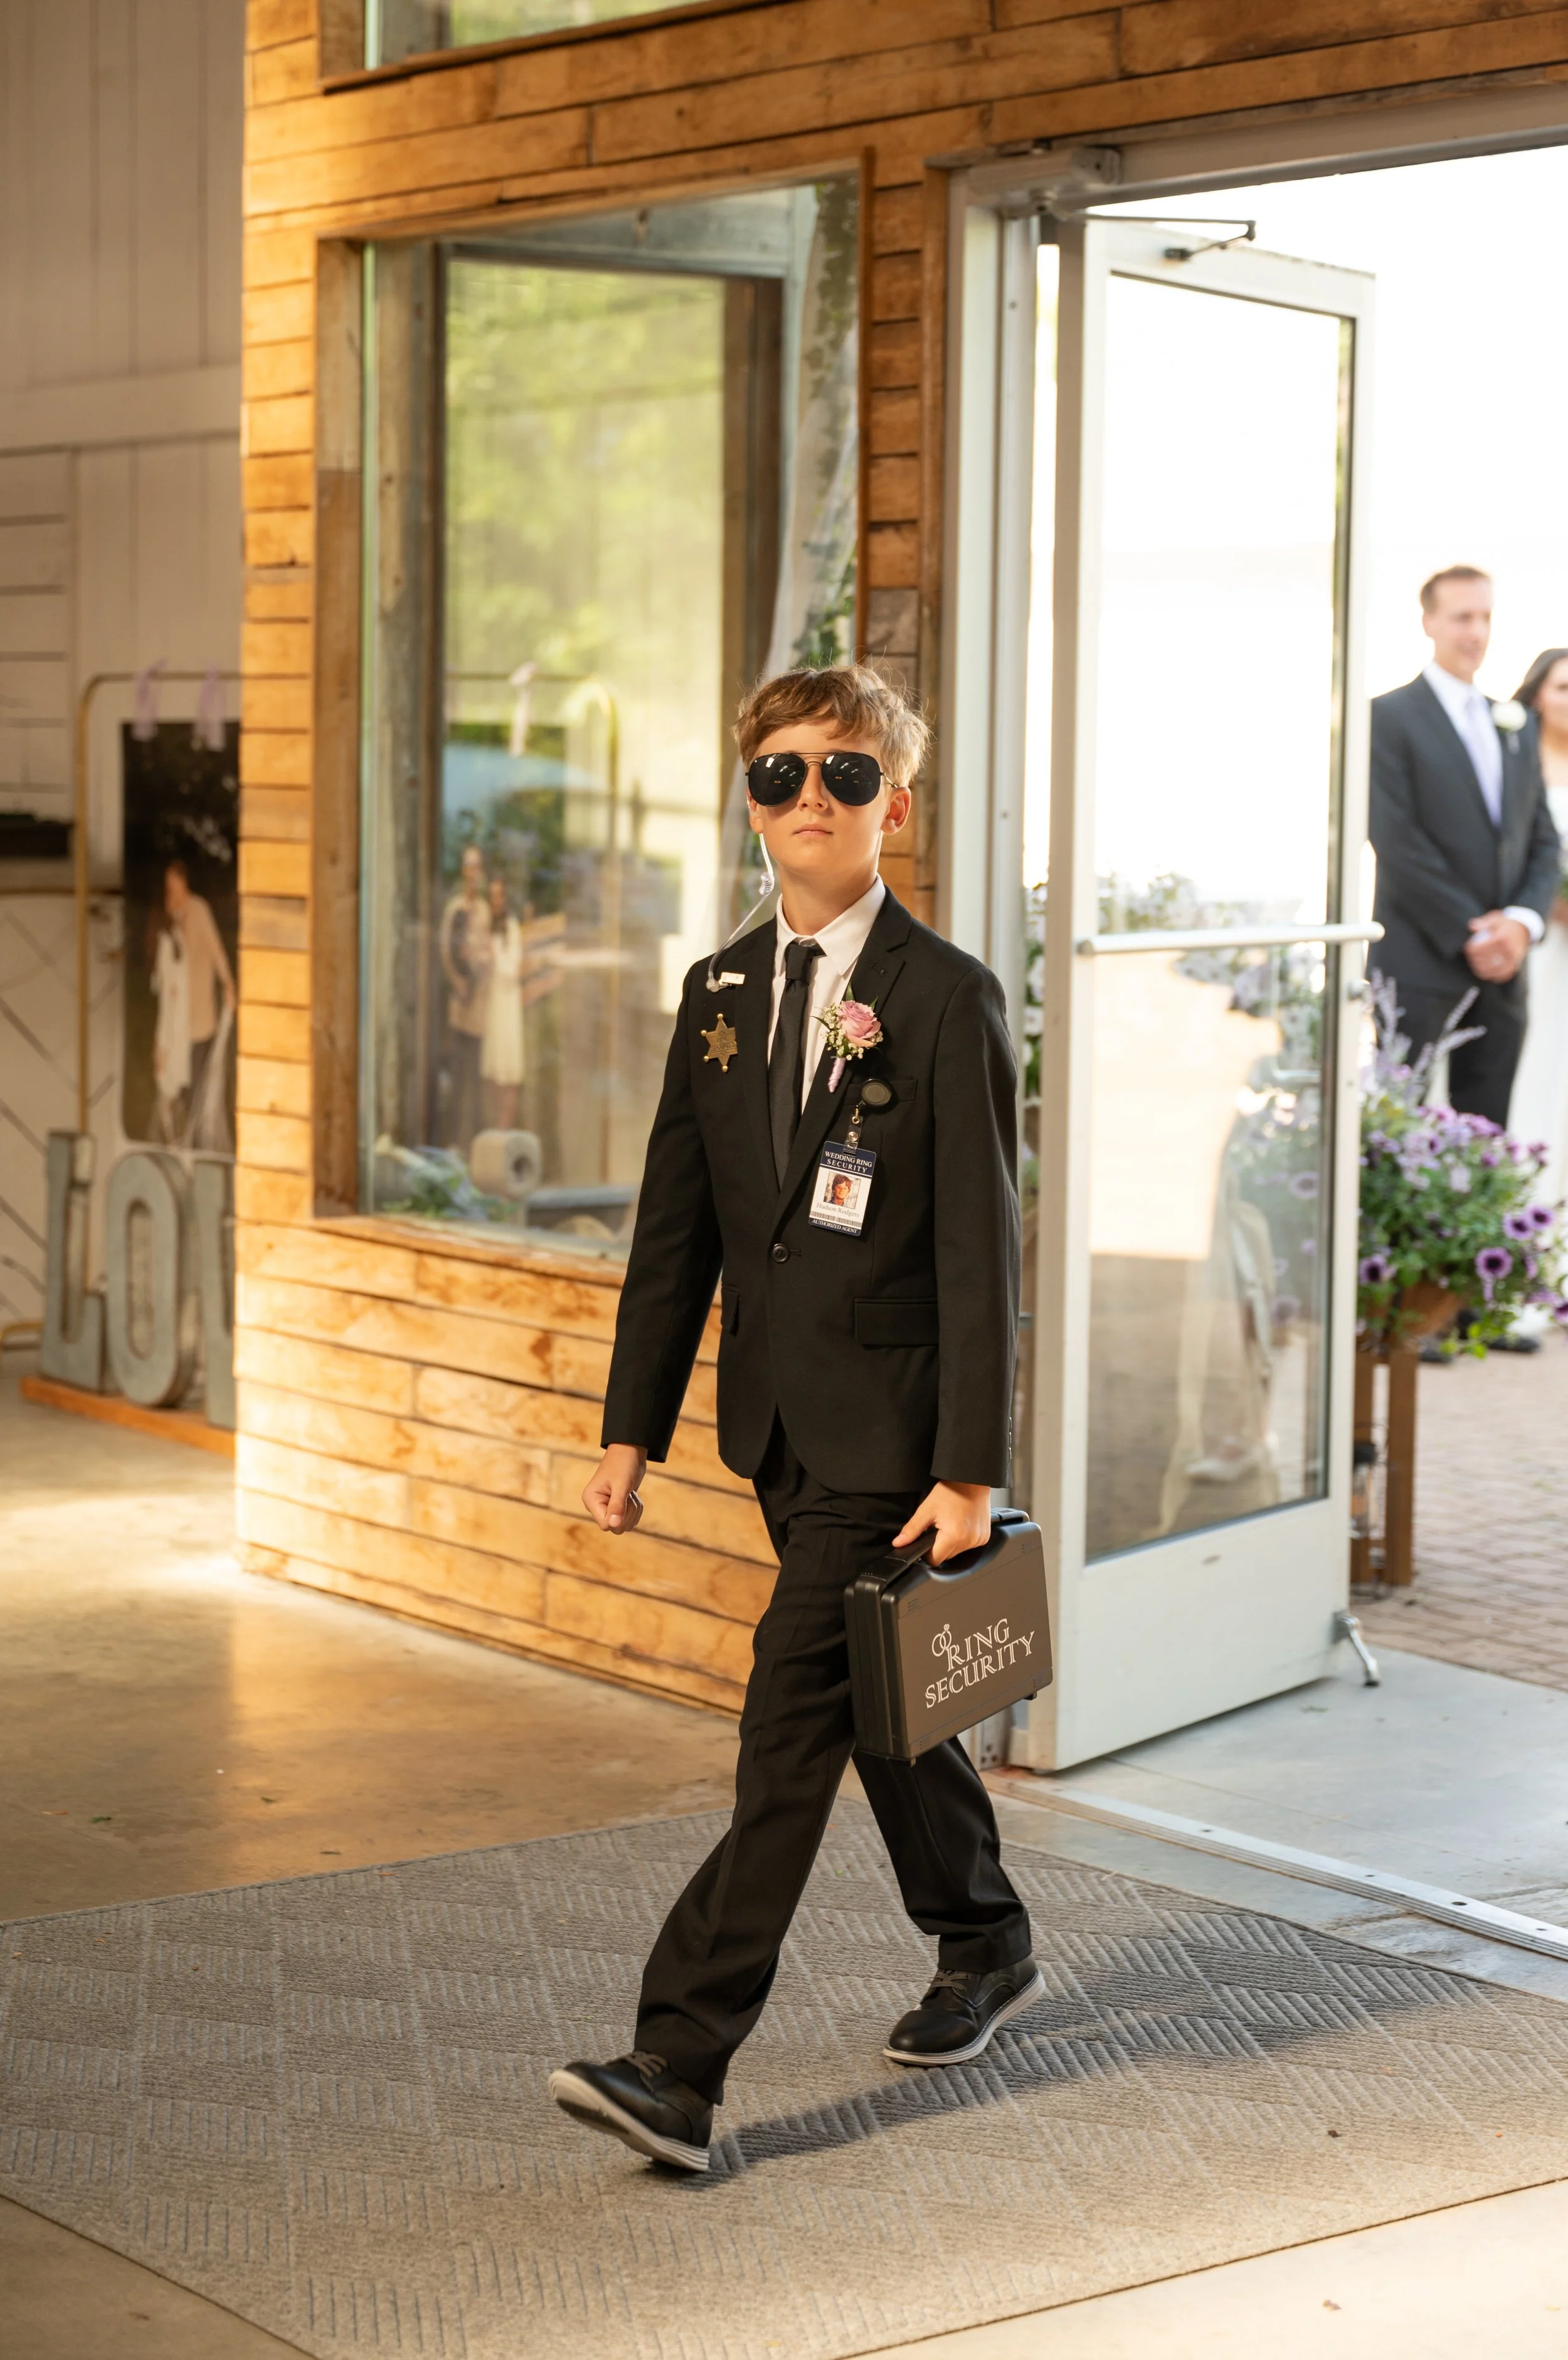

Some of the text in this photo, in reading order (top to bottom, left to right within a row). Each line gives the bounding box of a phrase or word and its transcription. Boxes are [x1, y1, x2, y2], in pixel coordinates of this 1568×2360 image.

[825, 1151, 872, 1167] WEDDING RING
[827, 1159, 867, 1173] SECURITY
[817, 1203, 859, 1218] Hudson Rodgers
[812, 1219, 841, 1230] AUTHORIZED
[947, 1618, 1010, 1672] RING
[925, 1631, 1035, 1708] SECURITY
